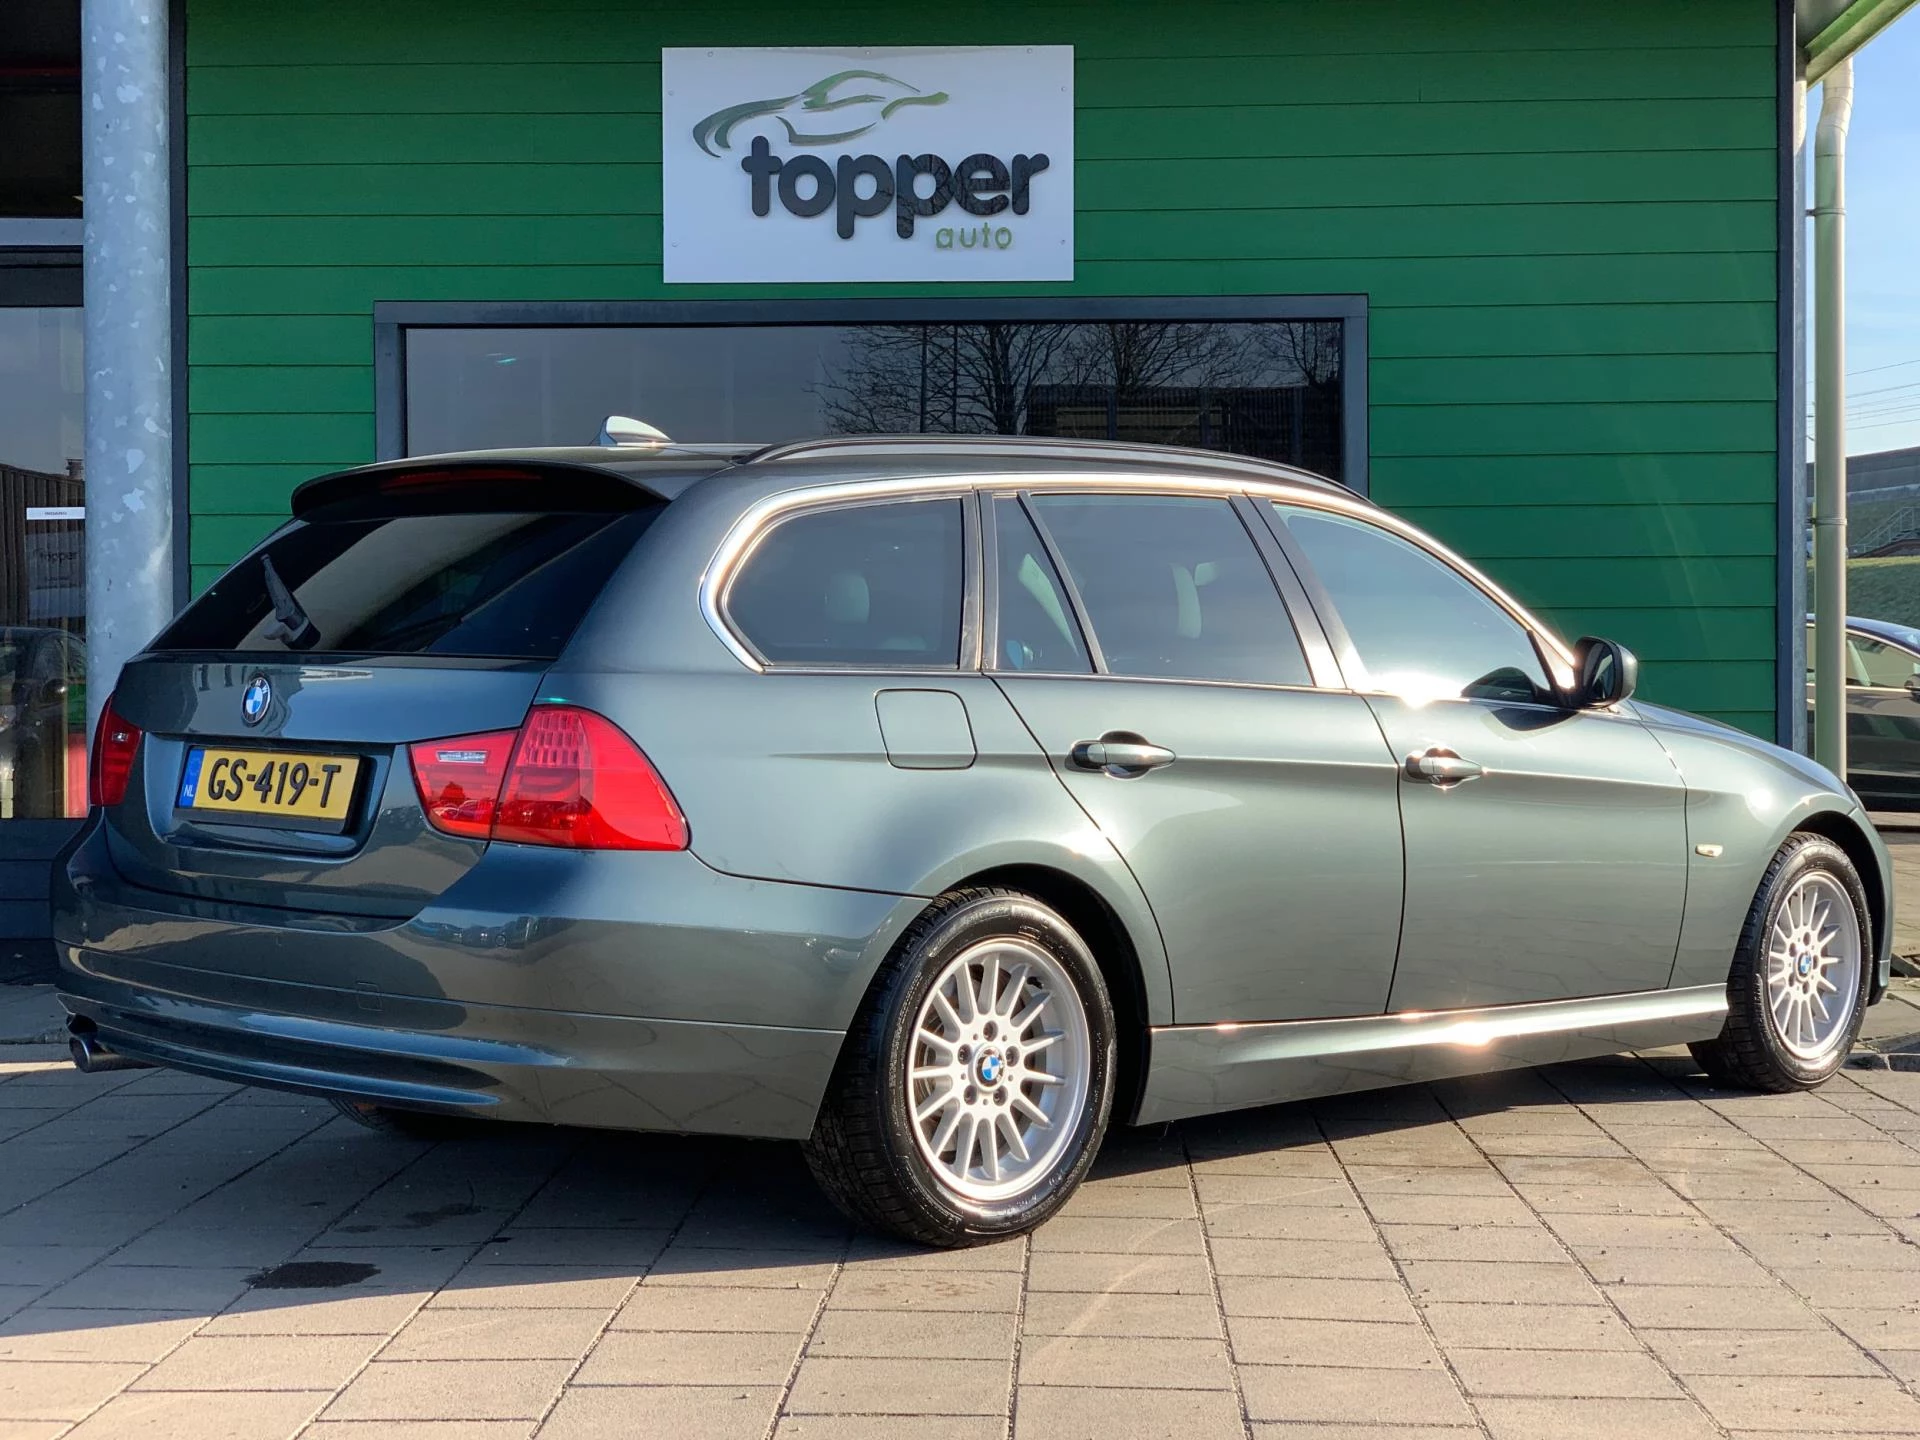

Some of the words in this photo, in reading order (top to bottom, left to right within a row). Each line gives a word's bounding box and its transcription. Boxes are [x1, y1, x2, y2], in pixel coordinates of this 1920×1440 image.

[741, 135, 1050, 239] topper
[935, 222, 1013, 249] auto
[183, 784, 194, 797] NL
[208, 757, 341, 808] GS-419-T
